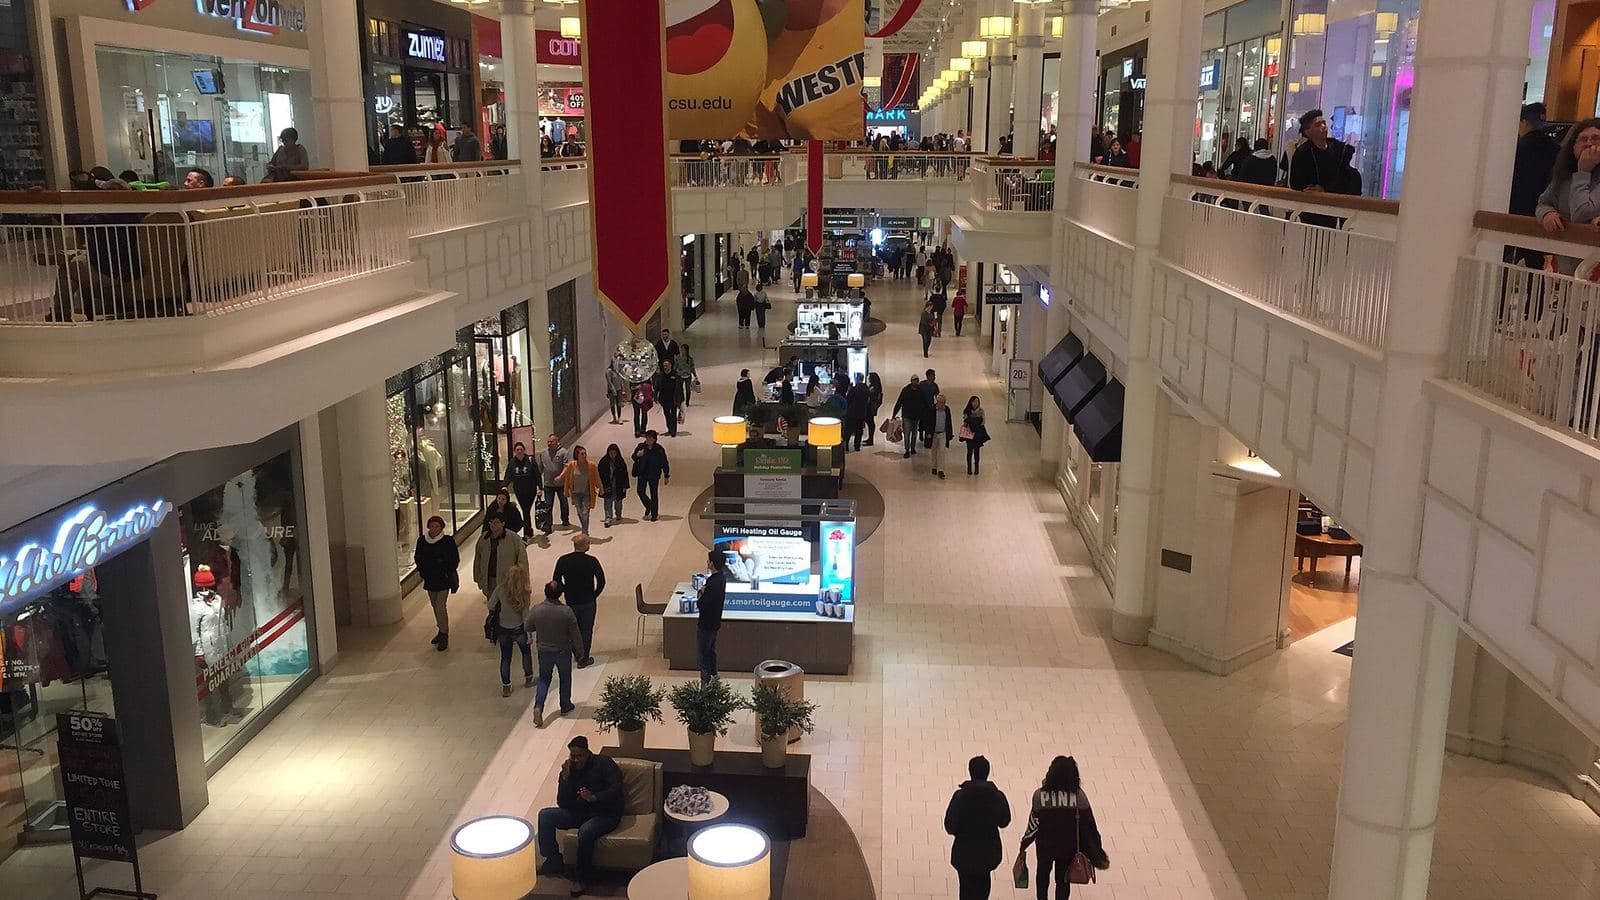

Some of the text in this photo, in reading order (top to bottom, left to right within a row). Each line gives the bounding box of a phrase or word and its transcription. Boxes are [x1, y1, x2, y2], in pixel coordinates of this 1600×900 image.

[668, 96, 732, 109] csu.edu
[740, 527, 767, 535] Heating
[70, 716, 103, 731] 50%
[67, 772, 98, 786] LIMITED
[1040, 790, 1077, 807] PINK
[73, 807, 119, 826] ENTIRE
[81, 821, 121, 837] STORE
